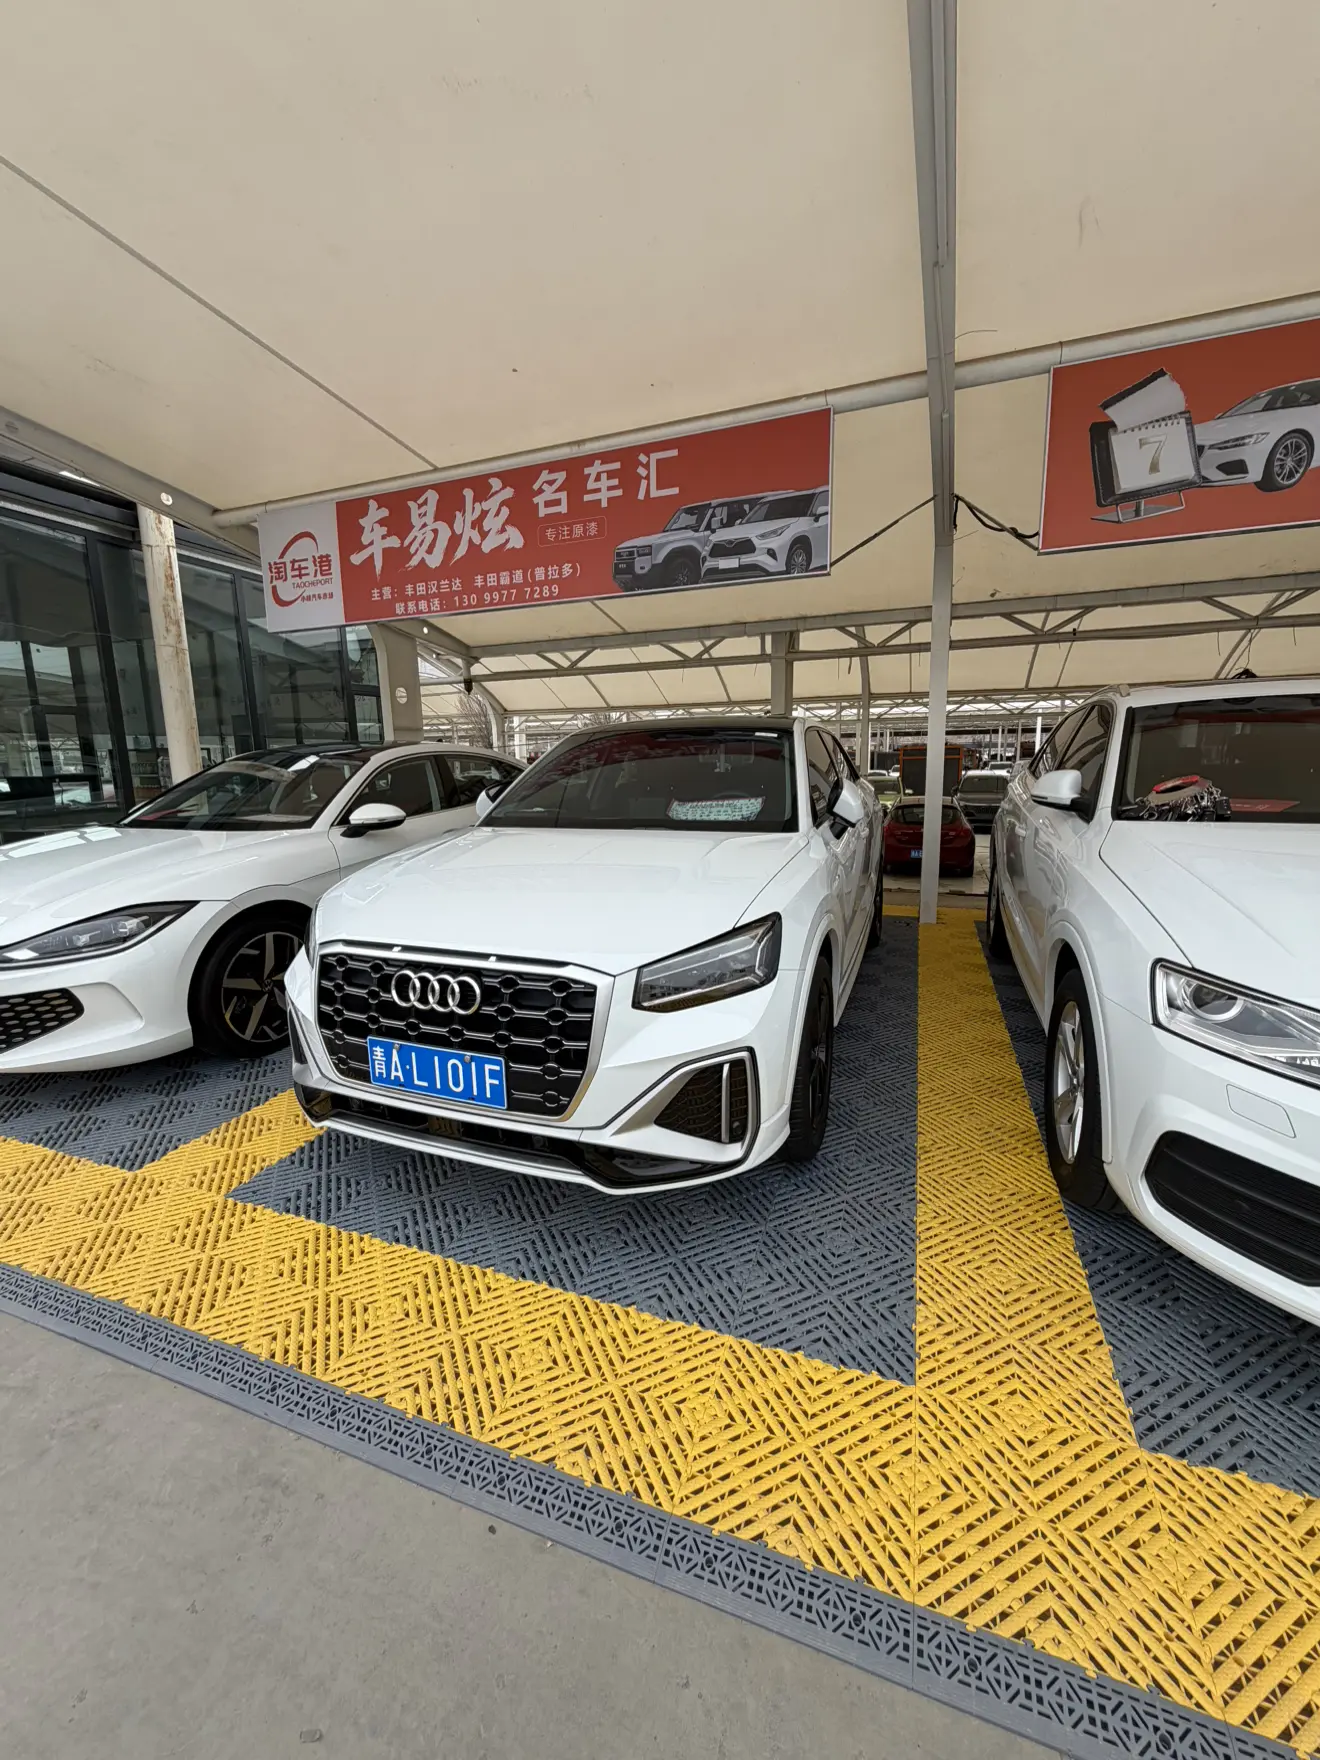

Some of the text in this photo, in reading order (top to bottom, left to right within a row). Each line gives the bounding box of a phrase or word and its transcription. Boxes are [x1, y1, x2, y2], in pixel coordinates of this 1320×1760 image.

[1138, 433, 1168, 476] 7
[350, 449, 680, 580] 车易炫 名车汇
[544, 520, 599, 542] 专注原漆
[268, 553, 333, 585] 淘车港
[292, 577, 333, 590] TAOCHEPORT
[484, 588, 517, 604] 9977
[525, 584, 560, 600] 7289
